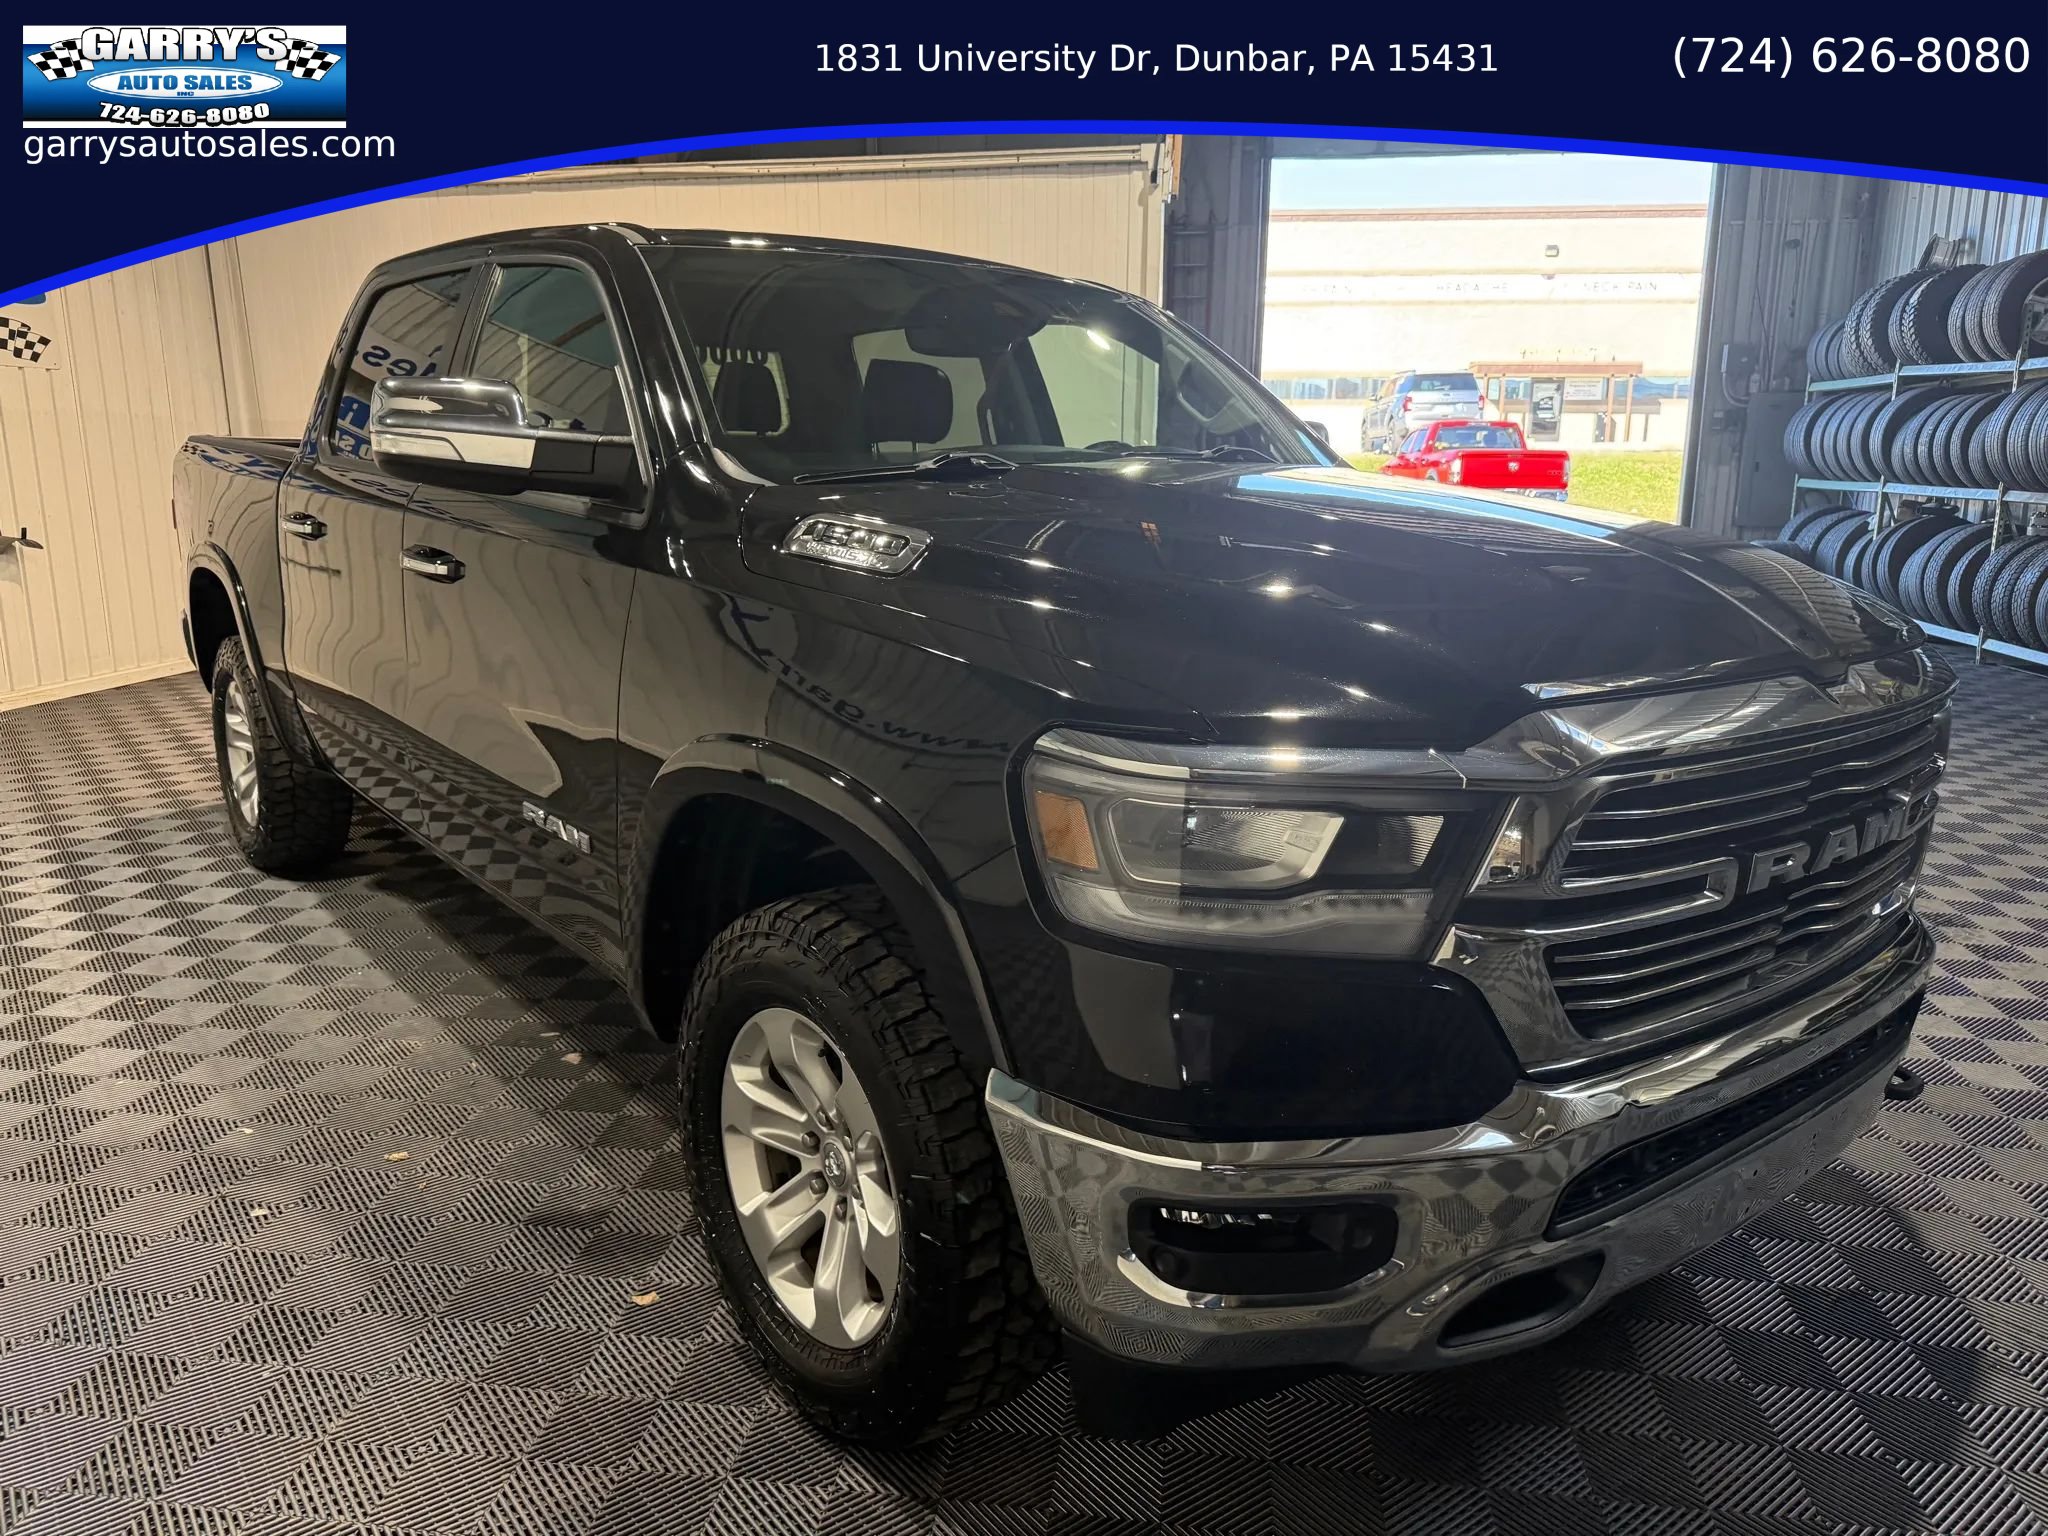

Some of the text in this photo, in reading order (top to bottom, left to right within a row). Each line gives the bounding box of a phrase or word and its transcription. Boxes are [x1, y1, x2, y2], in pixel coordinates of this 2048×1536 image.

[812, 521, 906, 556] 1500
[522, 800, 591, 855] RAM
[1746, 803, 1908, 895] RAM
